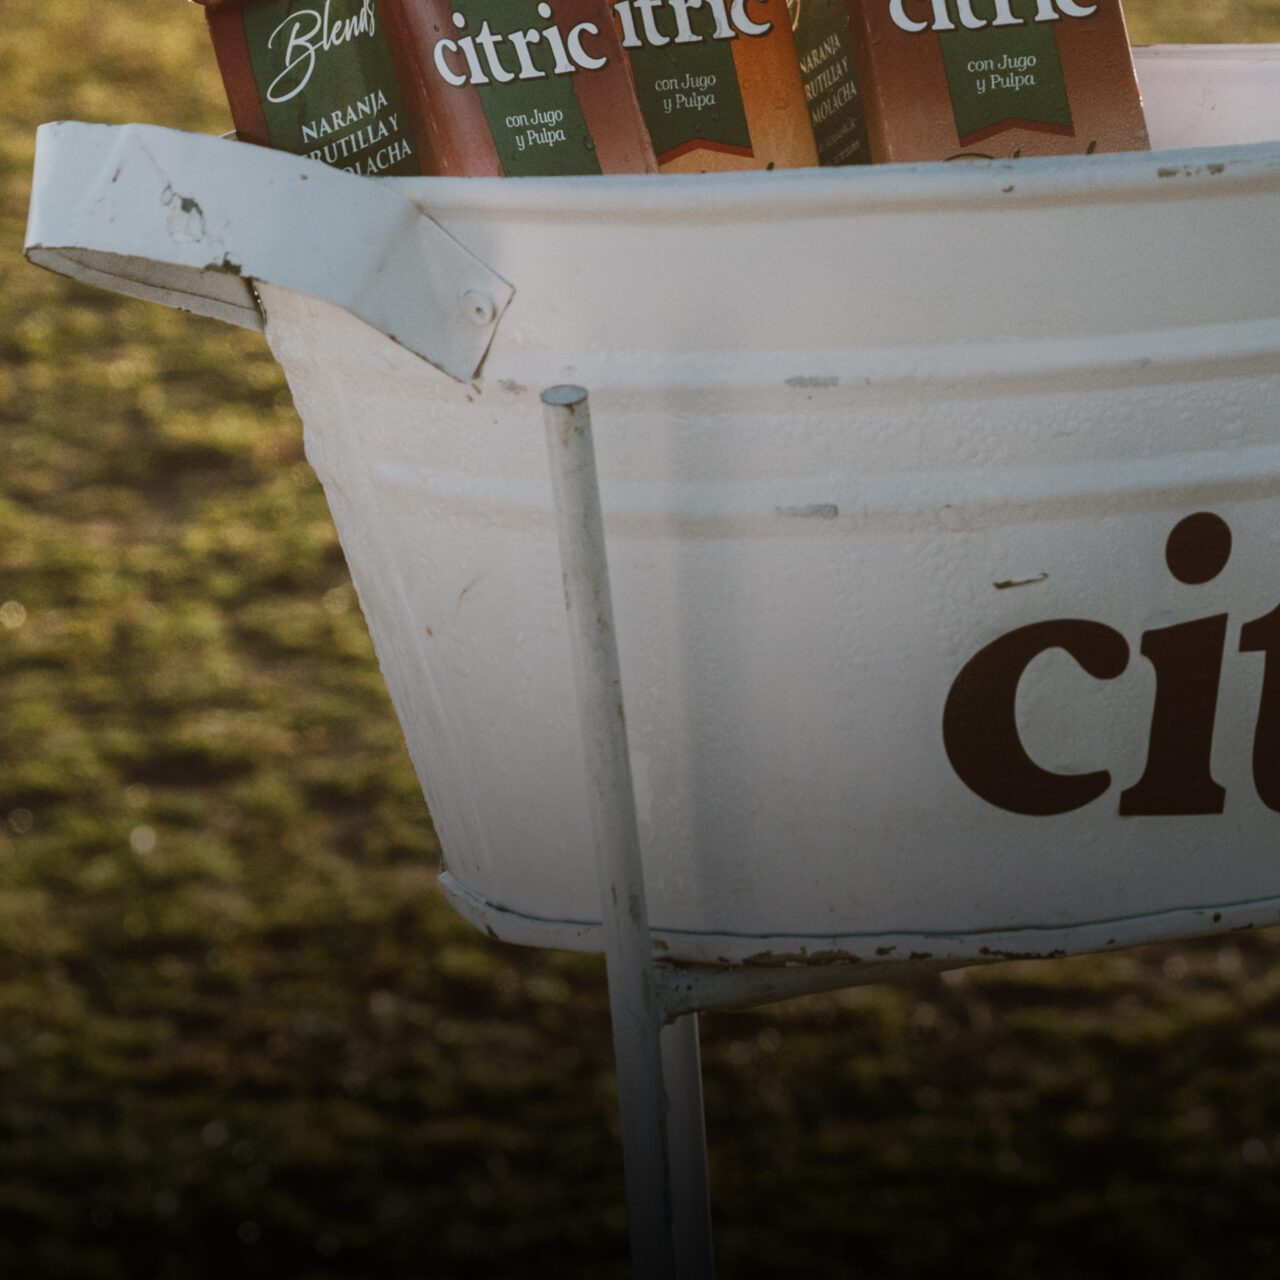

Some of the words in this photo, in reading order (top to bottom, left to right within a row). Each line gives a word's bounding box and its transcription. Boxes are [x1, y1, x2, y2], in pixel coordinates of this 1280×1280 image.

[433, 2, 607, 86] citric
[967, 59, 994, 72] con
[997, 54, 1037, 71] Jugo
[655, 78, 680, 91] con
[681, 73, 716, 91] Jugo
[804, 62, 843, 102] RUTILLA
[976, 78, 986, 94] y
[990, 72, 1036, 91] Pulpa
[663, 98, 672, 114] y
[675, 92, 716, 111] Pulpa
[301, 89, 388, 143] NARANJA
[506, 115, 530, 128] con
[530, 109, 563, 127] Jugo
[304, 120, 389, 164] RUTILLA
[388, 113, 398, 131] Y
[515, 135, 526, 151] y
[527, 128, 566, 147] Pulpa
